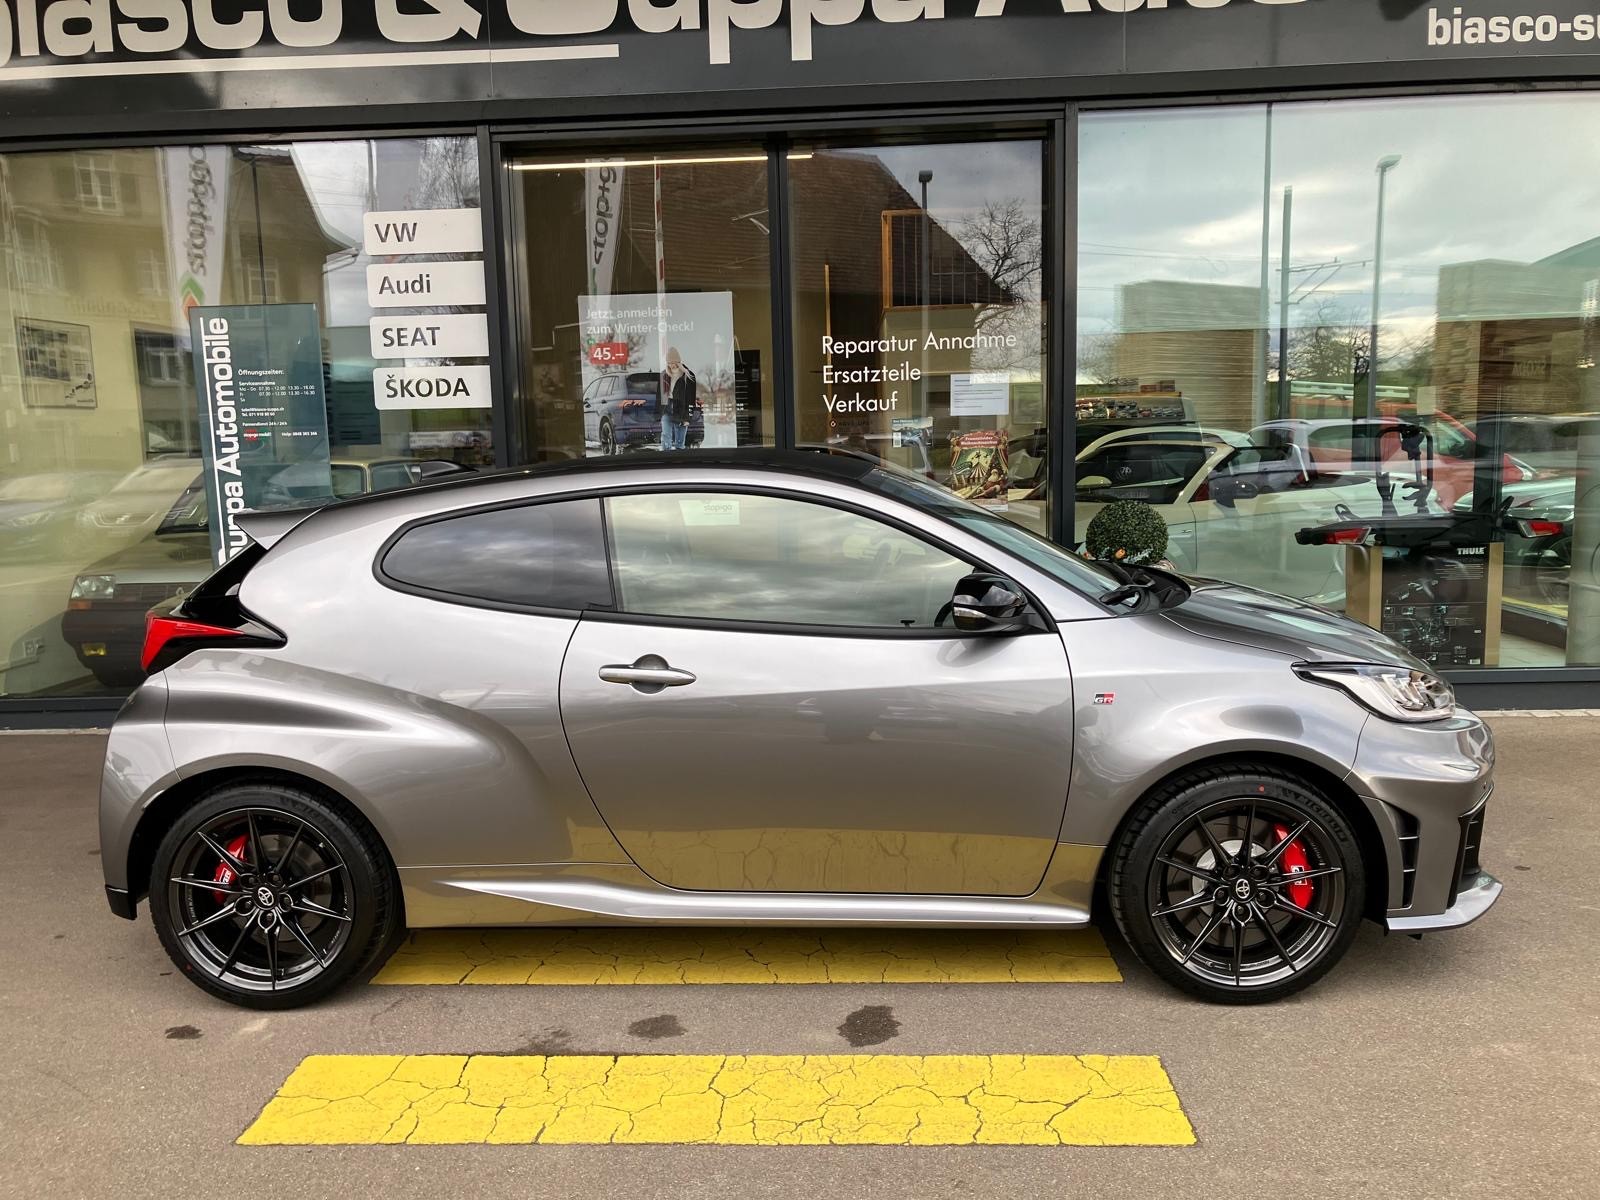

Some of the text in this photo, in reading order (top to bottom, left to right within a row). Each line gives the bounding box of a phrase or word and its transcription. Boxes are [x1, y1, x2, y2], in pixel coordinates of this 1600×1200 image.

[0, 0, 343, 68] iasco
[1427, 7, 1600, 46] biasco-s
[374, 222, 418, 243] VW
[378, 273, 432, 295] Audi
[616, 306, 673, 319] anmelden
[382, 326, 441, 348] SEAT
[586, 321, 694, 335] zum Winter-Check!
[822, 329, 1017, 359] Reparatur Annahme
[823, 360, 921, 385] Ersatzteile
[202, 317, 242, 477] Automobile
[385, 374, 470, 399] ŠKODA
[822, 390, 898, 413] Verkauf
[1457, 547, 1485, 555] THULE
